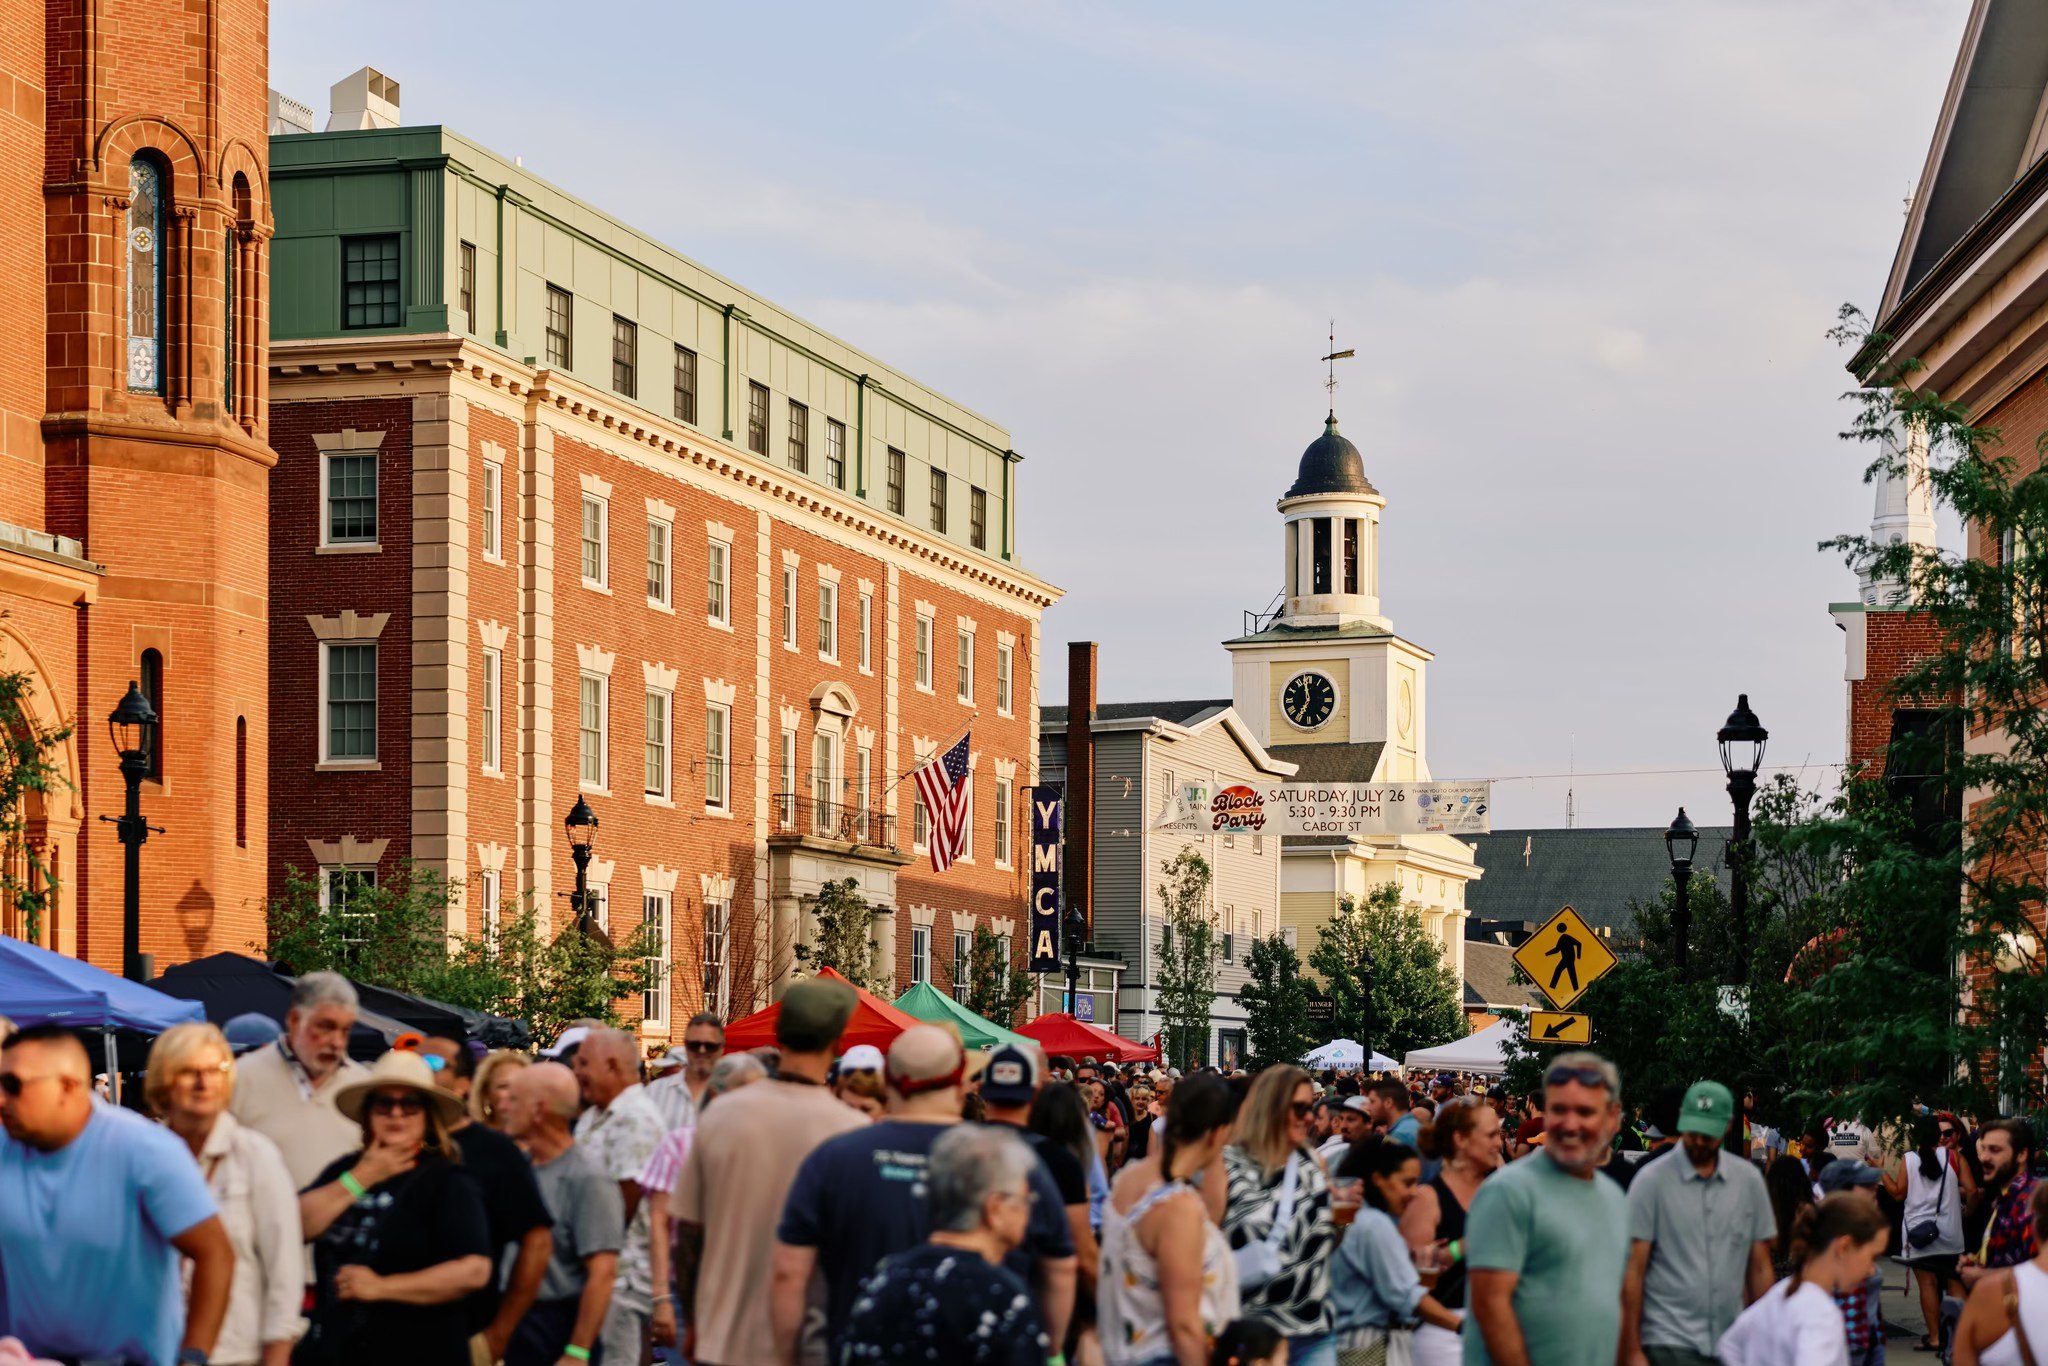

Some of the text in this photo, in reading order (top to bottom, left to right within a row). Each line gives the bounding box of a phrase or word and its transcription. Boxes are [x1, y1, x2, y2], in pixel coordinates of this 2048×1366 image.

[1211, 791, 1265, 812] Block
[1269, 790, 1405, 805] SATURDAY, JULY 26
[1289, 806, 1315, 818] 5:30
[1329, 806, 1356, 818] 9:30
[1361, 806, 1380, 818] PM
[1212, 812, 1267, 831] Party
[1302, 822, 1361, 831] CABOT ST
[1034, 801, 1057, 959] YMCA
[1078, 1003, 1092, 1018] cycle
